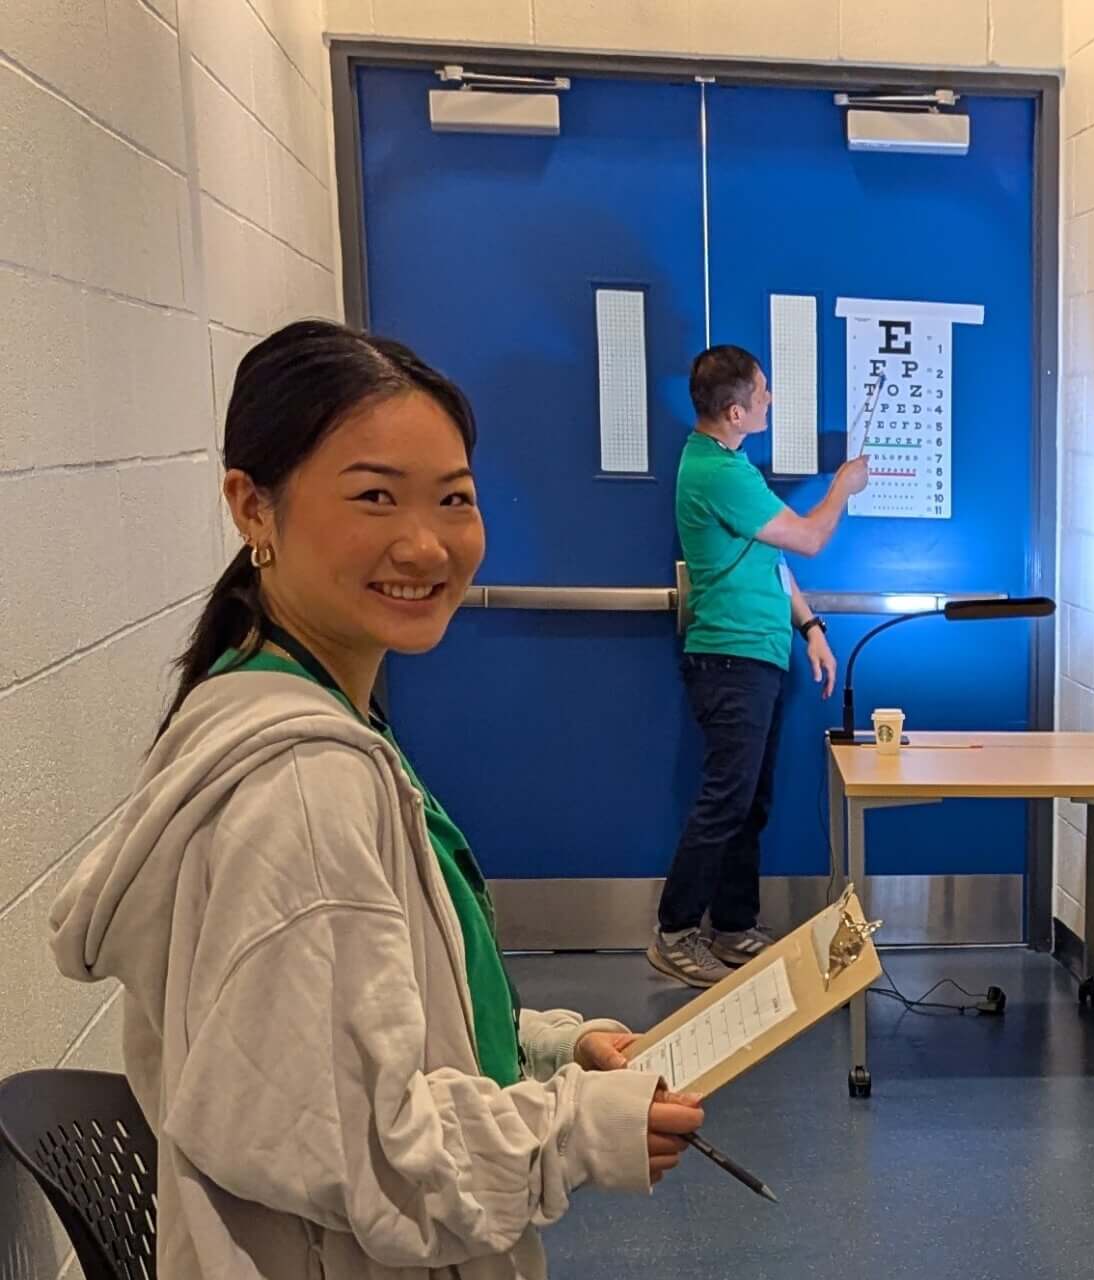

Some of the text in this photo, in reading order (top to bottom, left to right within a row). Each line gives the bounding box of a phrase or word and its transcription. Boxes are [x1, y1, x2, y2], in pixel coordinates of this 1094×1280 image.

[878, 319, 911, 355] E
[901, 360, 919, 378] P
[936, 369, 944, 379] 2
[936, 389, 944, 399] 3
[934, 405, 943, 415] 4
[936, 422, 943, 432] 5
[936, 437, 943, 448] 6
[935, 453, 943, 463] 7
[936, 467, 943, 477] 8
[936, 480, 943, 490] 9
[934, 494, 944, 503] 10
[935, 505, 942, 515] 11
